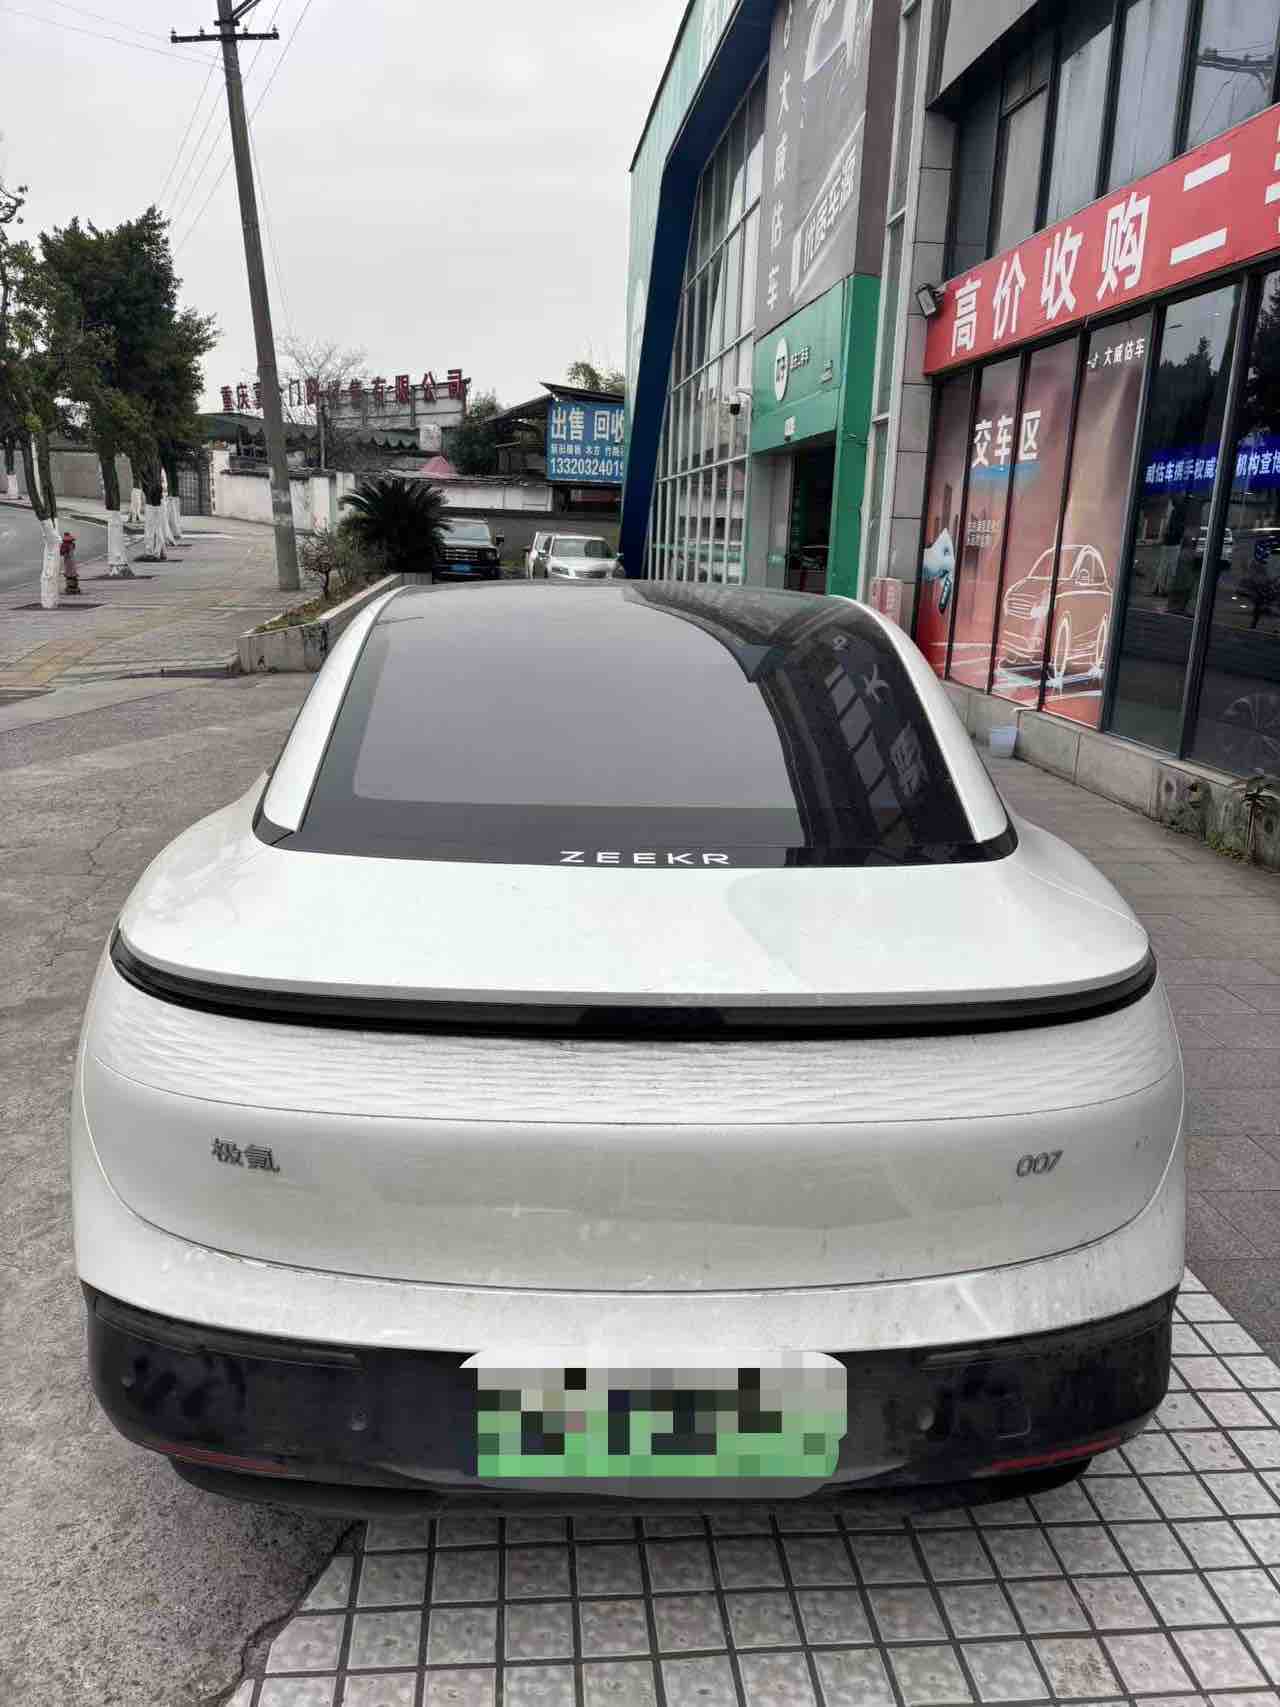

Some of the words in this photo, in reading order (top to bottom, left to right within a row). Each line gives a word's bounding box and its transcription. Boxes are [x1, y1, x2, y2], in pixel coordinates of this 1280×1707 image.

[1103, 338, 1145, 368] 大威估车
[551, 406, 584, 440] 出售
[594, 408, 624, 443] 回收
[972, 409, 1041, 471] 交车区
[559, 850, 730, 865] ZEEKR
[210, 1137, 281, 1173] 极氪
[1016, 1149, 1064, 1177] 007
